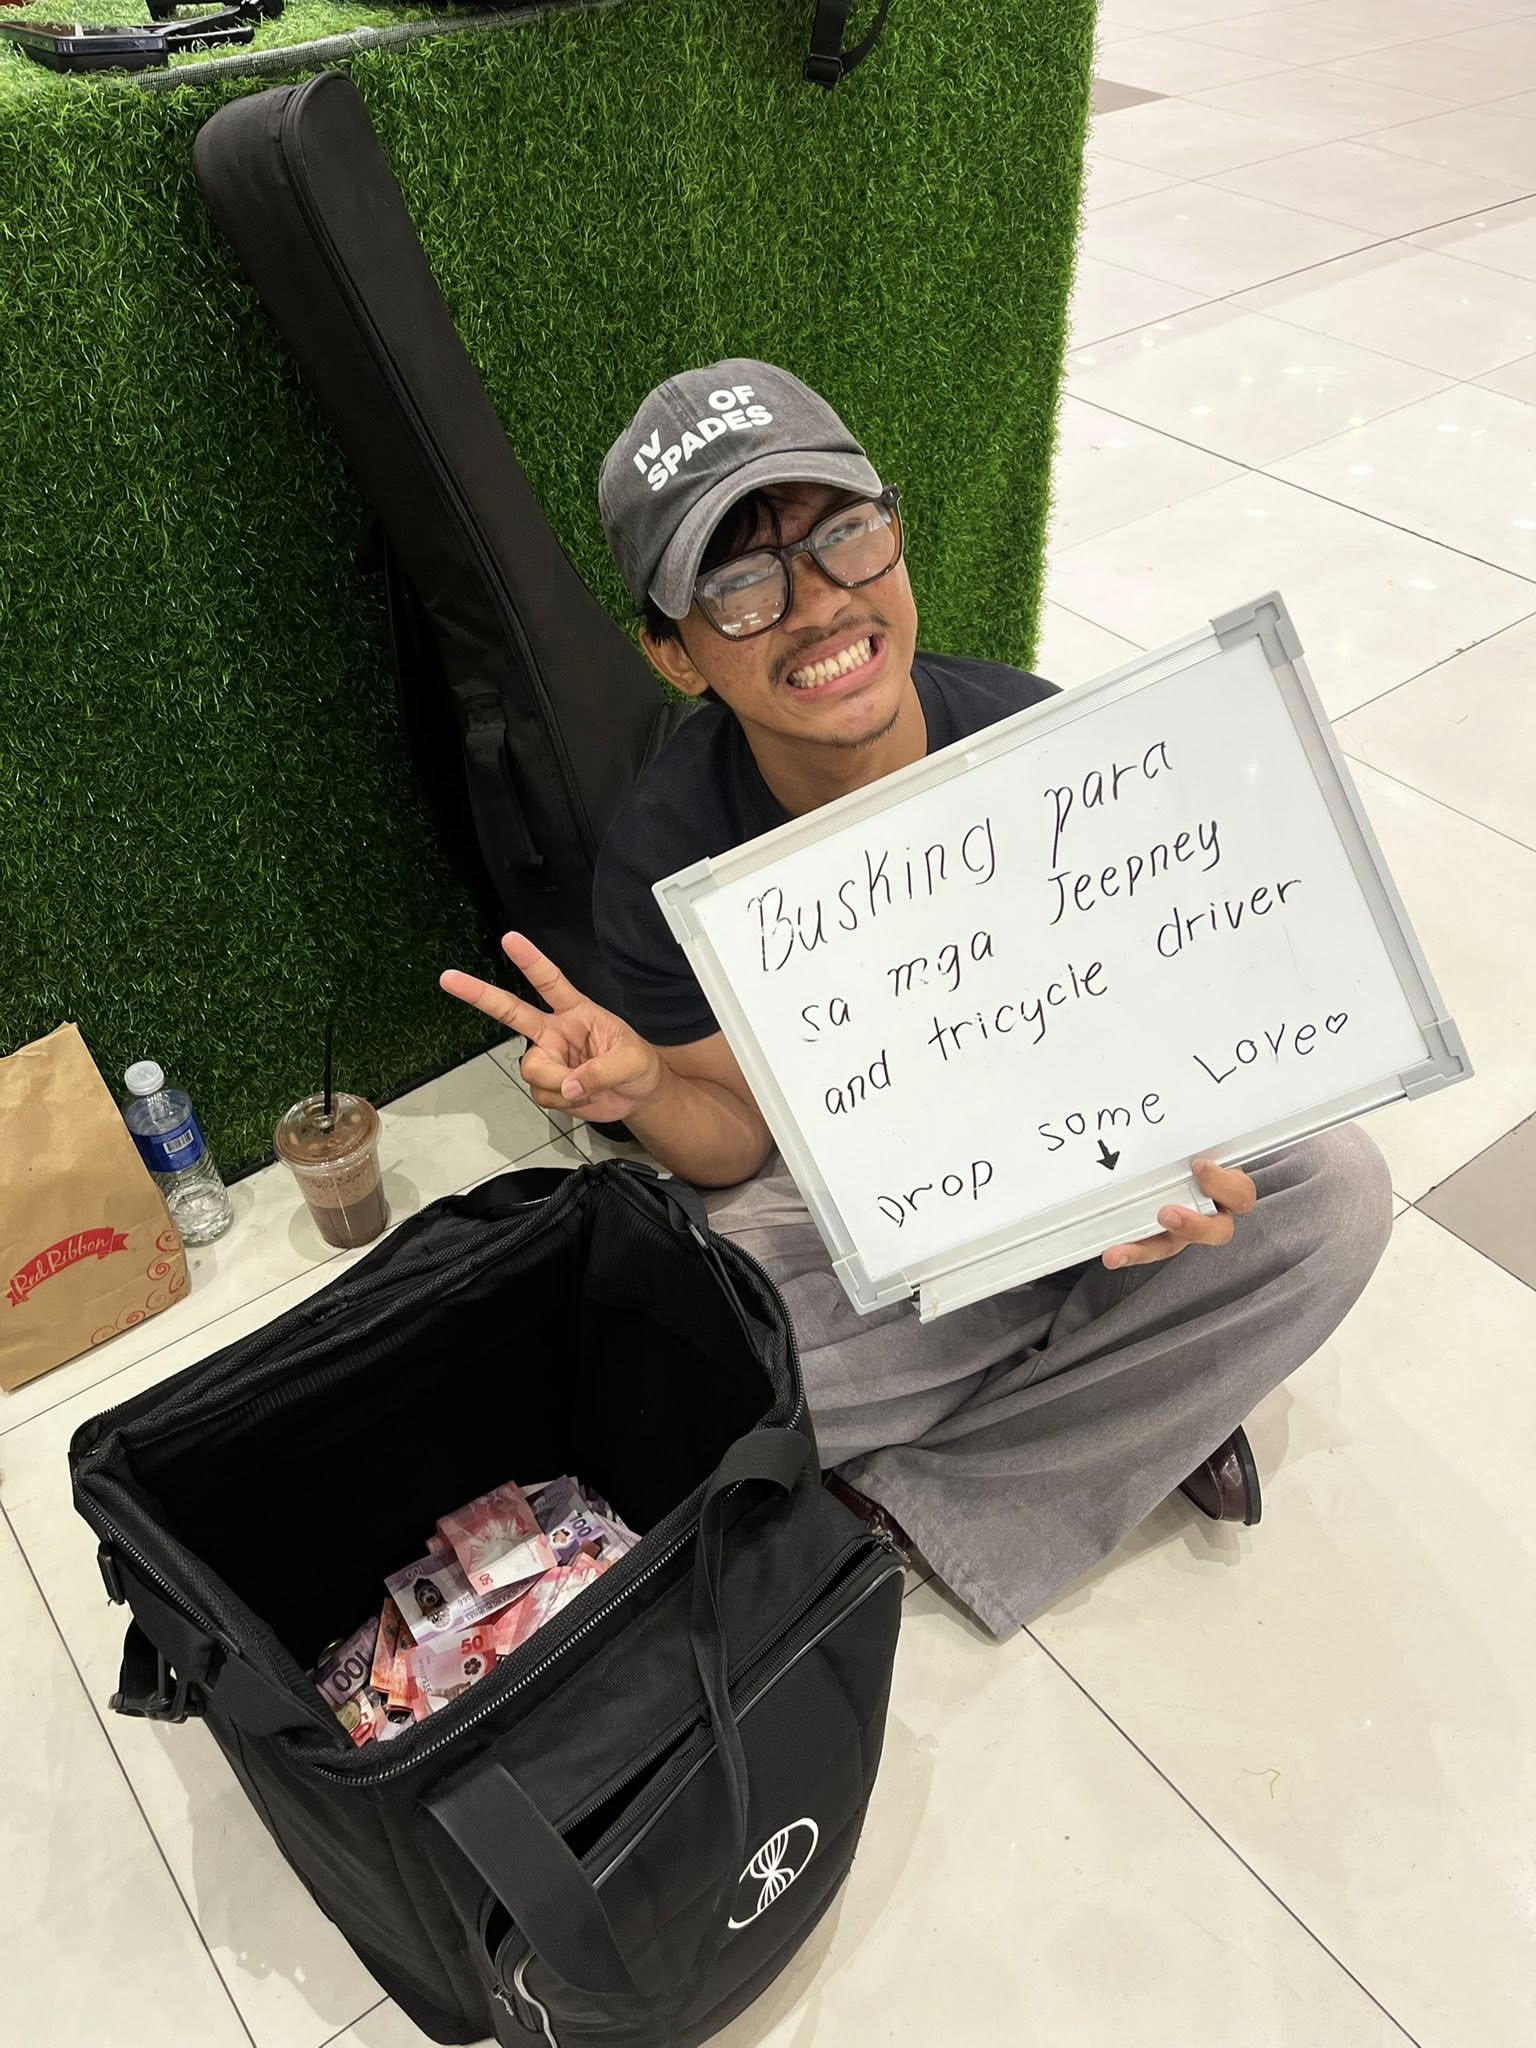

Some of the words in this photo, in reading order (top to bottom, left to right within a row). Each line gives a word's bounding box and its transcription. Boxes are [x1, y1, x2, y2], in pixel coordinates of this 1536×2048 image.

[632, 428, 661, 475] IV
[707, 384, 756, 412] OF
[646, 404, 774, 492] SPADES
[747, 817, 996, 972] Busking
[1043, 740, 1173, 869] para
[801, 997, 851, 1043] sa
[886, 930, 995, 997] mga
[1047, 819, 1221, 926] Jeepney
[824, 1048, 892, 1115] and
[1156, 878, 1302, 958] driver
[1037, 1092, 1166, 1152] some
[1192, 1022, 1318, 1084] Love
[12, 1259, 50, 1296] Red
[46, 1234, 108, 1273] Ribbon
[568, 1511, 593, 1538] 100
[331, 1650, 370, 1693] 100
[460, 1634, 485, 1655] 50
